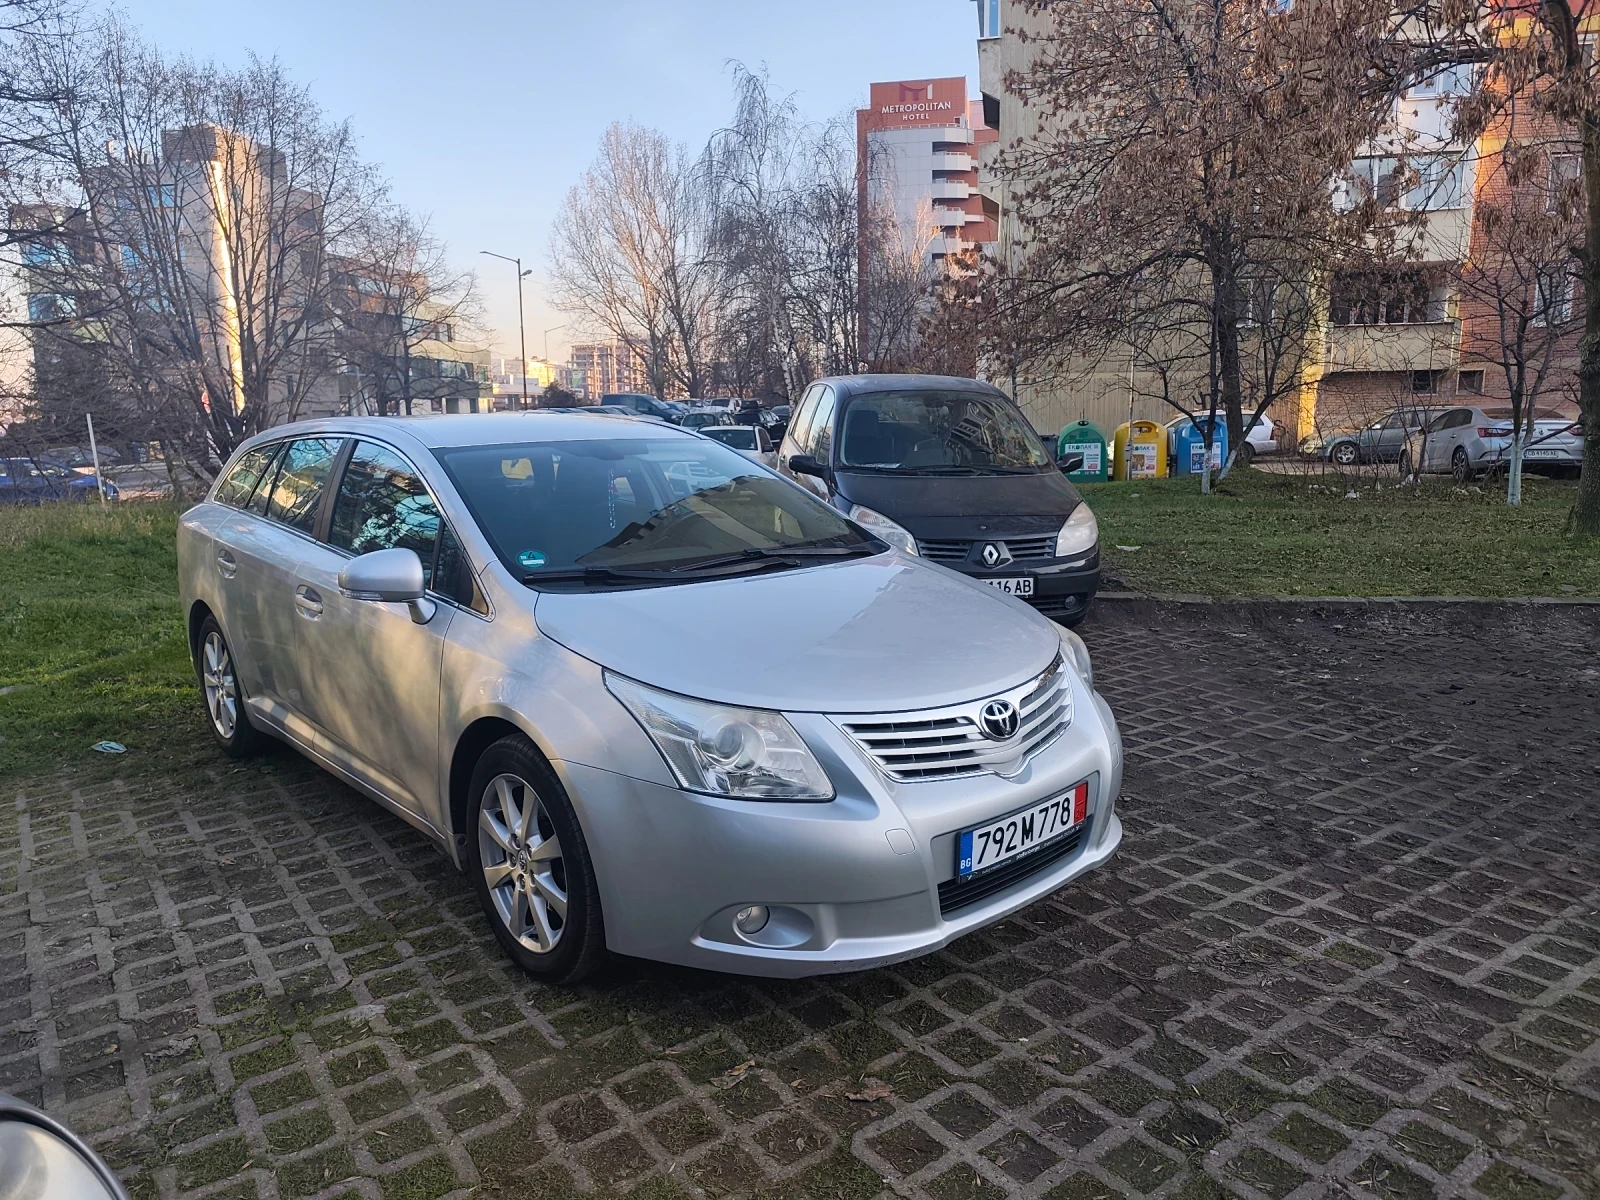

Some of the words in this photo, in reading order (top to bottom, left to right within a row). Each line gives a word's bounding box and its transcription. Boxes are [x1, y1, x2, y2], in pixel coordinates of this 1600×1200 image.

[881, 101, 951, 114] METROPOLITAN
[902, 113, 930, 121] HOTEL
[1014, 579, 1032, 594] AB
[960, 857, 972, 870] BG
